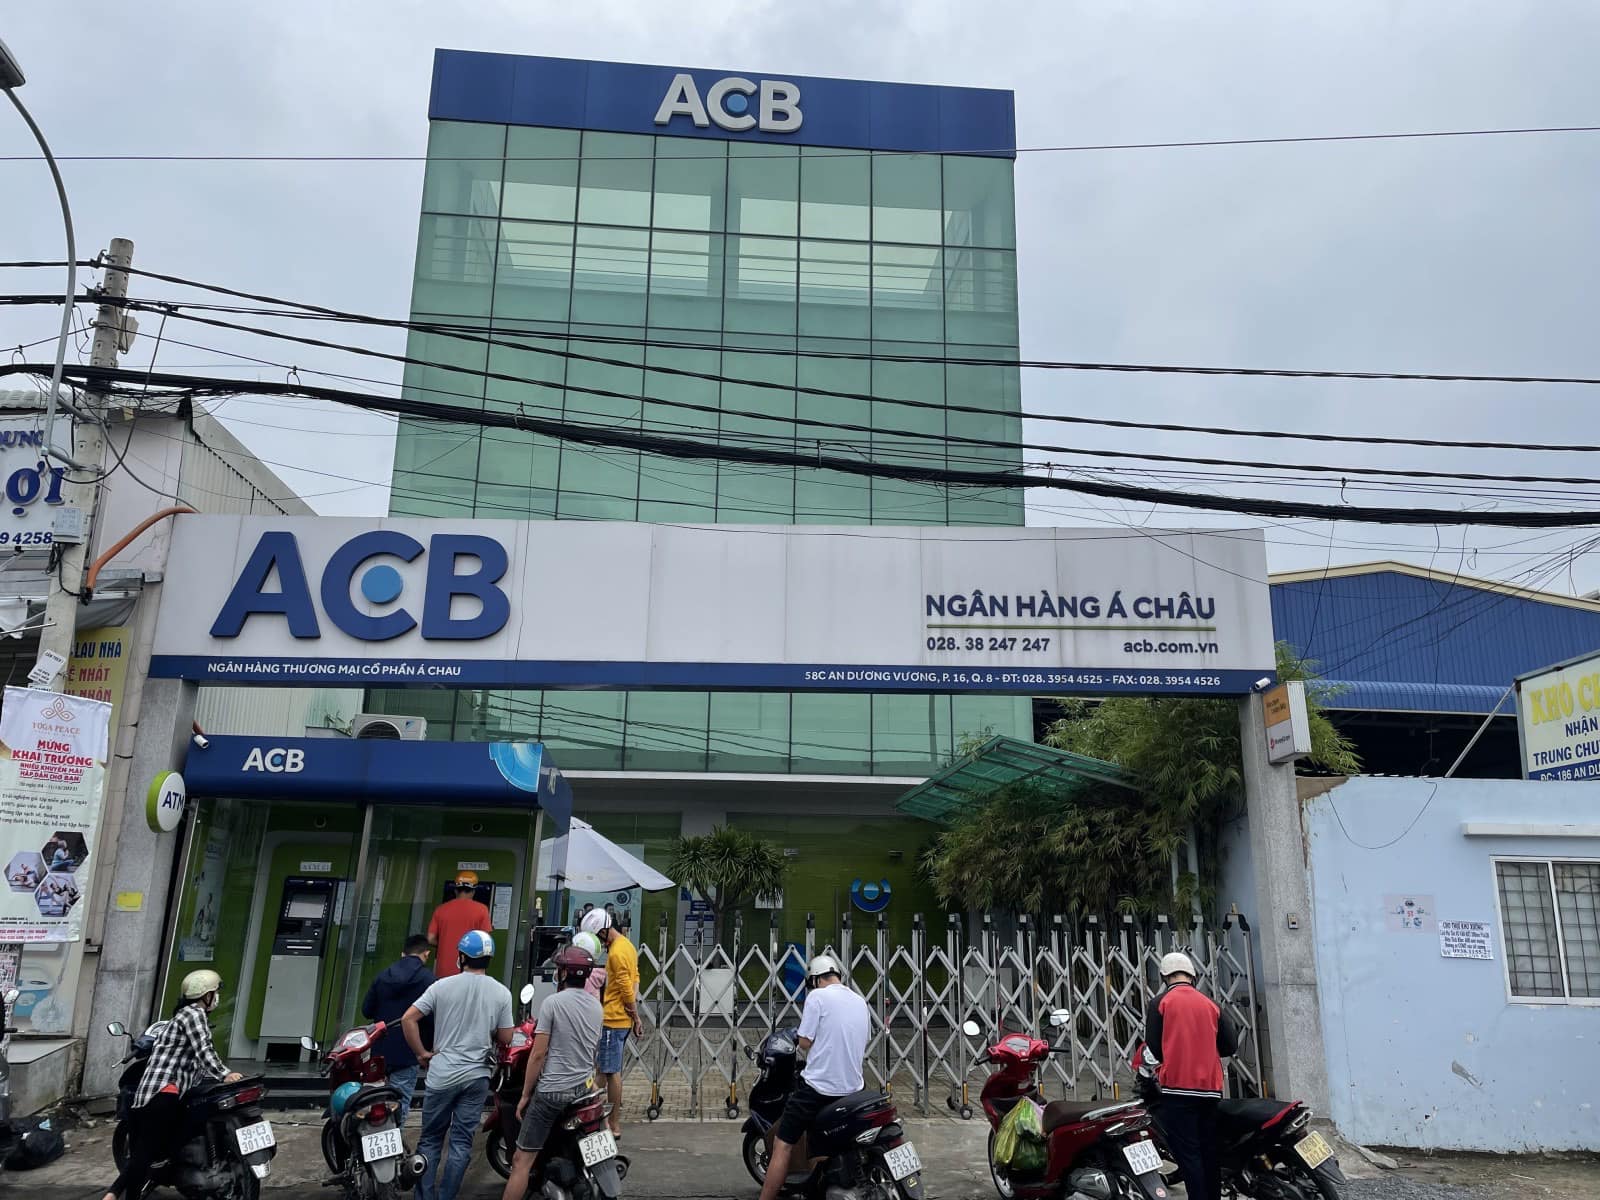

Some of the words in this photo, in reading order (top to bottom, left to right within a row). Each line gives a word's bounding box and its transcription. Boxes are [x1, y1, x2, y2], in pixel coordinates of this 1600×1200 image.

[653, 73, 803, 133] ACB
[12, 531, 53, 545] 4258
[209, 530, 511, 641] ACB
[926, 589, 1009, 618] NGÂN
[1015, 590, 1101, 618] HÀNG
[1106, 590, 1128, 619] Á
[1132, 592, 1215, 620] CHÂU
[926, 636, 961, 651] 028.
[965, 637, 984, 651] 38
[988, 637, 1018, 651] 247
[1022, 637, 1050, 651] 247
[1123, 639, 1219, 654] acb.com.vn
[207, 661, 243, 673] NGÂN
[245, 661, 280, 674] HÀNG
[338, 665, 360, 677] MẠI
[804, 670, 826, 681] 58C
[828, 671, 845, 681] AN
[986, 673, 993, 683] 8
[1022, 674, 1046, 684] 028.
[1047, 674, 1074, 684] 3954
[1076, 675, 1103, 685] 4525
[1112, 675, 1138, 685] FAX:
[1139, 675, 1163, 685] 028.
[1165, 676, 1191, 686] 3954
[1193, 676, 1221, 686] 4526
[1530, 681, 1575, 726] KHO
[1565, 715, 1599, 738] NHẬN
[12, 749, 42, 762] KHAI
[242, 747, 305, 773] ACB
[1533, 746, 1572, 767] TRUNG
[1575, 739, 1600, 758] CHU
[1574, 766, 1586, 778] AN
[161, 790, 185, 812] ATM
[367, 1131, 395, 1148] 72-T2
[370, 1142, 397, 1159] 8838
